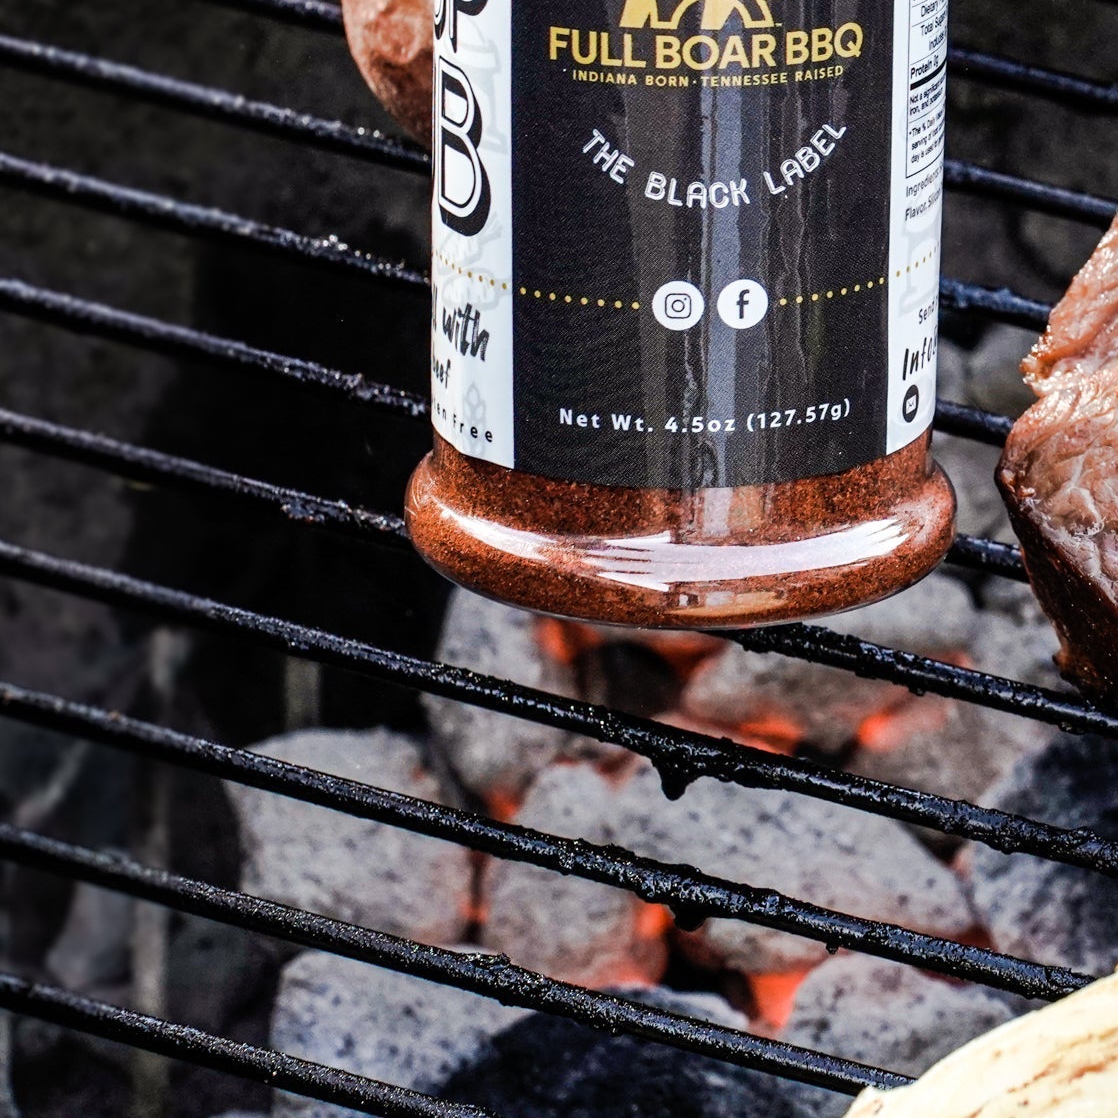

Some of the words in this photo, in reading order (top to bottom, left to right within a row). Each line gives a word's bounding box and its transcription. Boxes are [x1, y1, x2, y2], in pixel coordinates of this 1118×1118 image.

[921, 20, 934, 36] Total
[550, 26, 646, 68] FULL
[655, 33, 776, 70] BOAR
[785, 22, 863, 66] BBQ
[572, 69, 637, 85] INDIANA
[645, 74, 688, 87] BORN
[700, 72, 787, 87] TENNESSEE
[795, 65, 844, 82] RAISED
[911, 60, 933, 79] Protein
[581, 128, 635, 185] THE
[644, 171, 751, 209] BLACK
[762, 122, 847, 195] LABEL
[443, 303, 490, 362] with
[453, 414, 493, 443] Free
[559, 408, 601, 429] Net
[611, 413, 654, 433] Wt.
[665, 416, 736, 434] 4.5oz
[746, 398, 851, 433] (127.57g)
